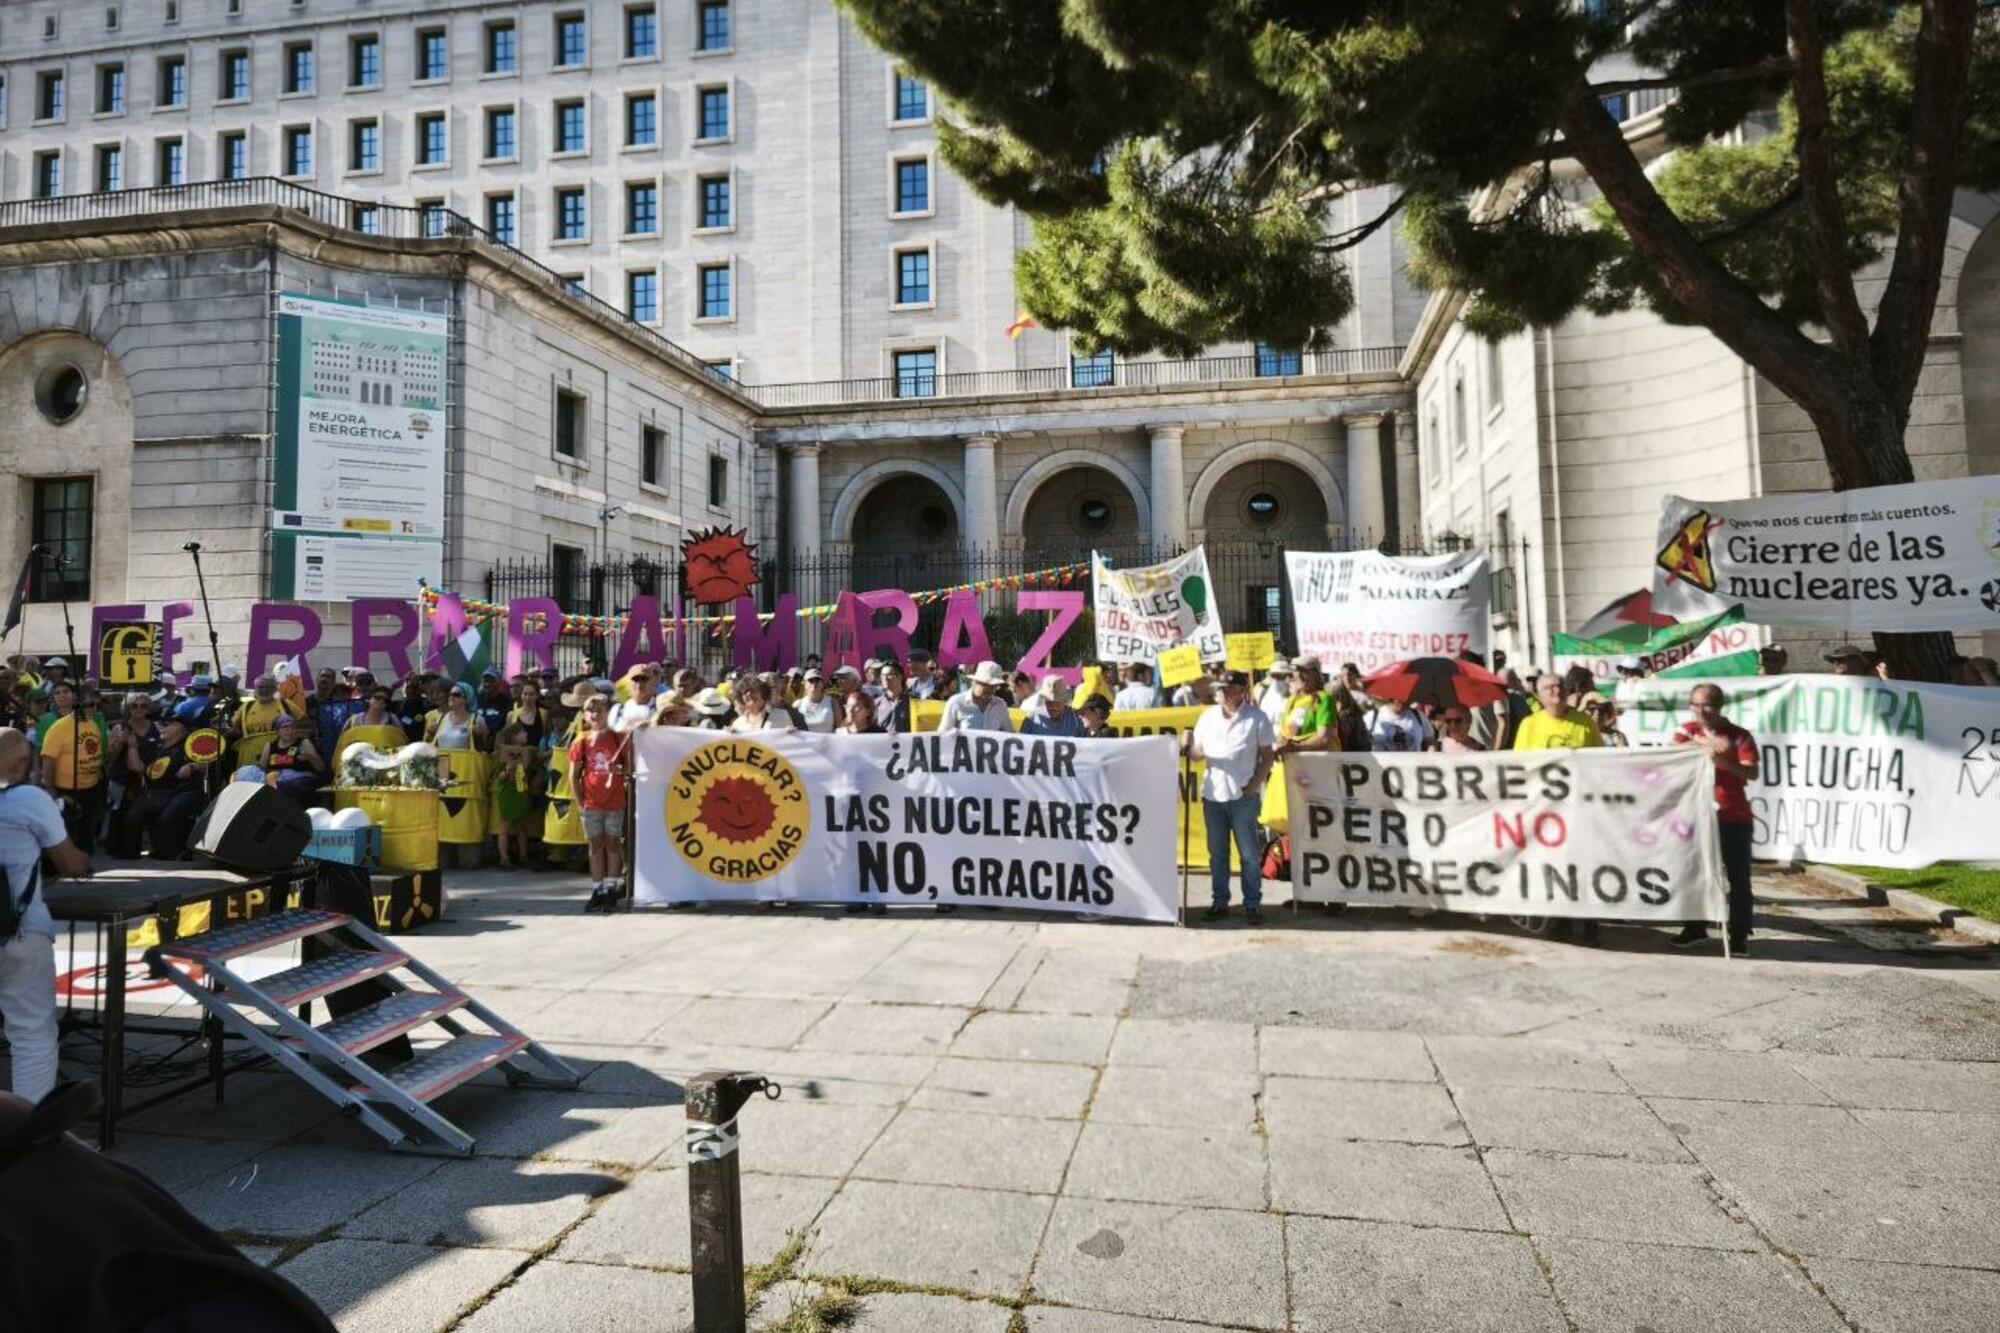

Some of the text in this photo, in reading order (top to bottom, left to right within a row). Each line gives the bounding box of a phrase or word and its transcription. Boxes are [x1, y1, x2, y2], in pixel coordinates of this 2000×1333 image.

[310, 411, 366, 424] MEJORA
[1772, 516, 1800, 527] nos
[1887, 504, 1956, 520] cuentos.
[1727, 531, 1945, 564] Cierre de las
[1730, 571, 1969, 606] nucleares ya.
[1370, 631, 1472, 653] ESTUPIDEZ
[1711, 627, 1747, 653] NO
[673, 744, 802, 802] ¿NUCLEAR?
[886, 734, 1077, 780] ¿ALARGAR
[825, 794, 1140, 846] LAS NUCLEARES?
[1309, 805, 1567, 850] PERO NO
[672, 822, 802, 878] NO GRACIAS
[858, 840, 1114, 906] NO, GRACIAS
[1302, 852, 1671, 906] POBRECINOS
